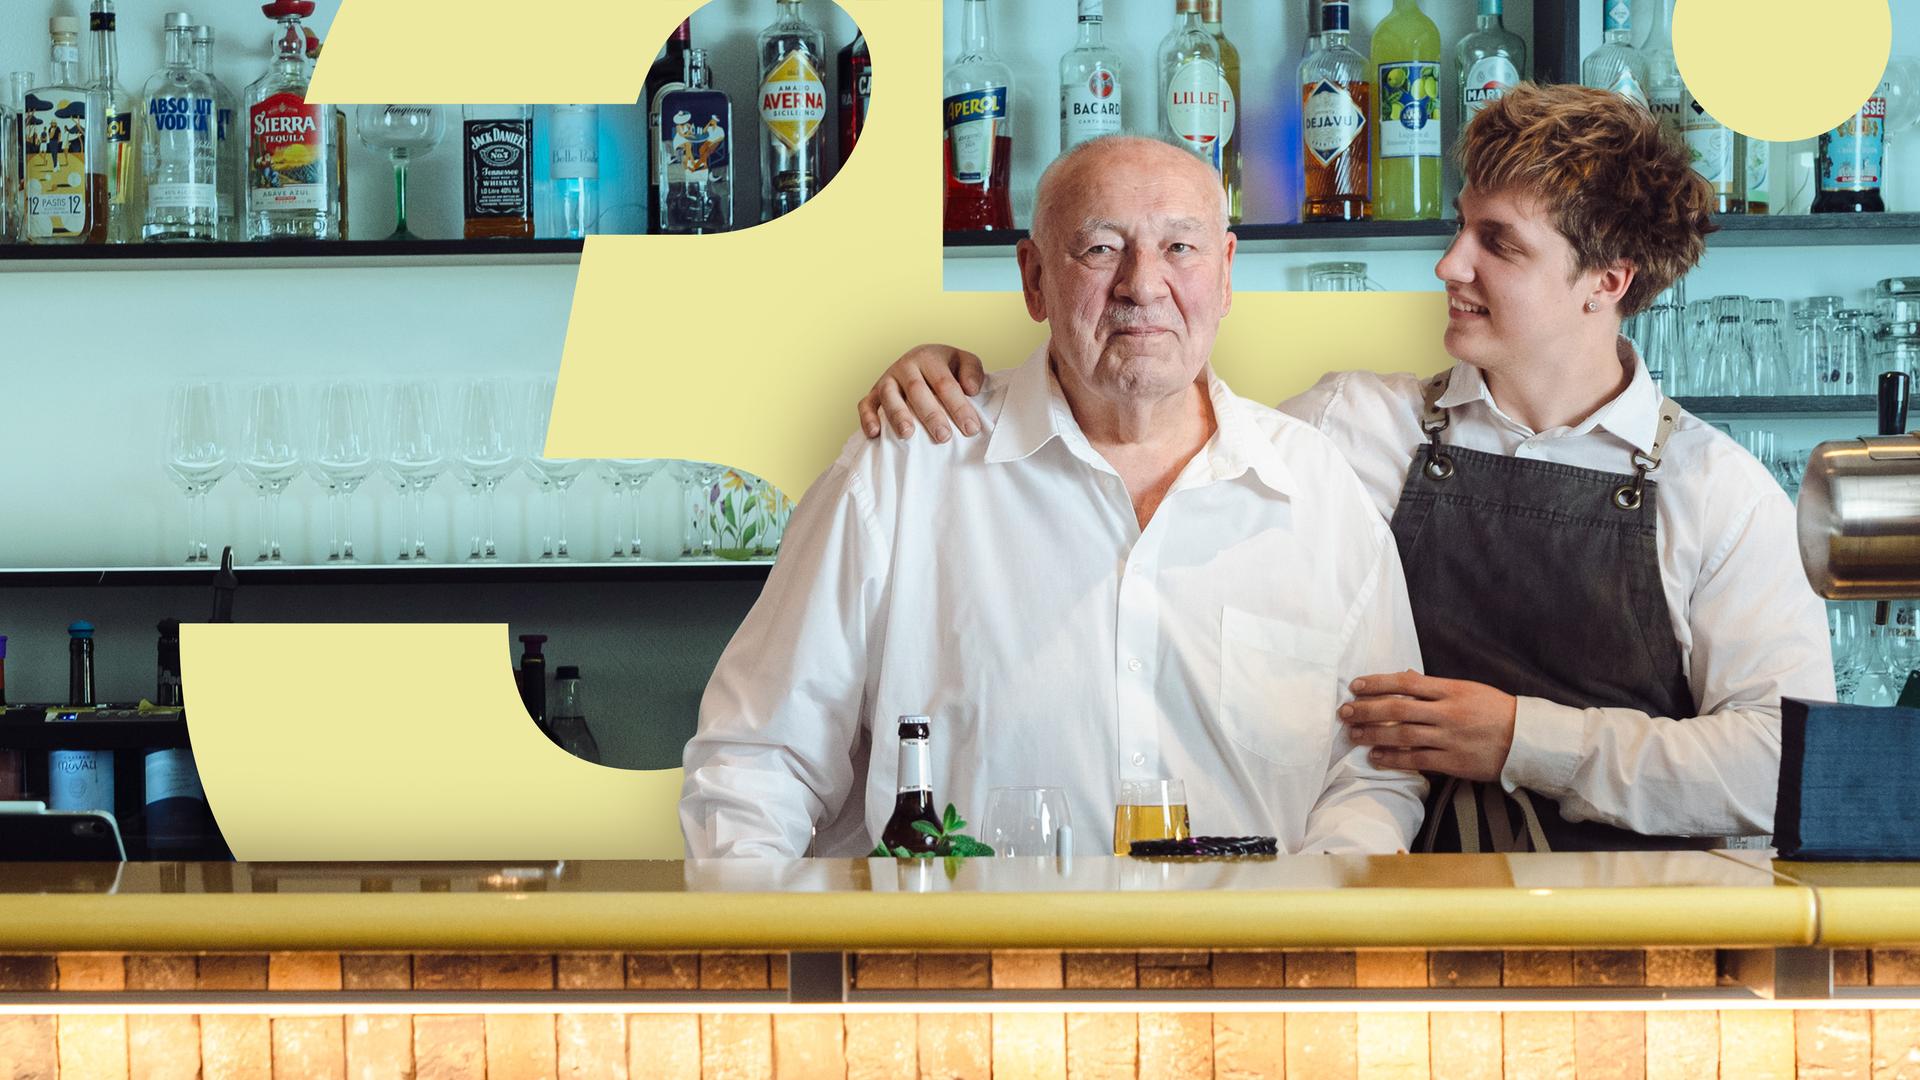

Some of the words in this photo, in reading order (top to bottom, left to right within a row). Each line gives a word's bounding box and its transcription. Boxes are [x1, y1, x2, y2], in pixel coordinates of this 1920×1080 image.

[149, 98, 212, 115] ABSOUT
[384, 103, 432, 117] Tanqueray
[948, 96, 1000, 119] APEROL
[1073, 102, 1121, 115] BACARD
[155, 114, 208, 131] VODKA
[255, 111, 317, 135] SIERRA
[265, 134, 305, 143] TEQUILA
[471, 131, 493, 150] JACK
[481, 167, 519, 176] Tennessee
[69, 195, 81, 214] 12
